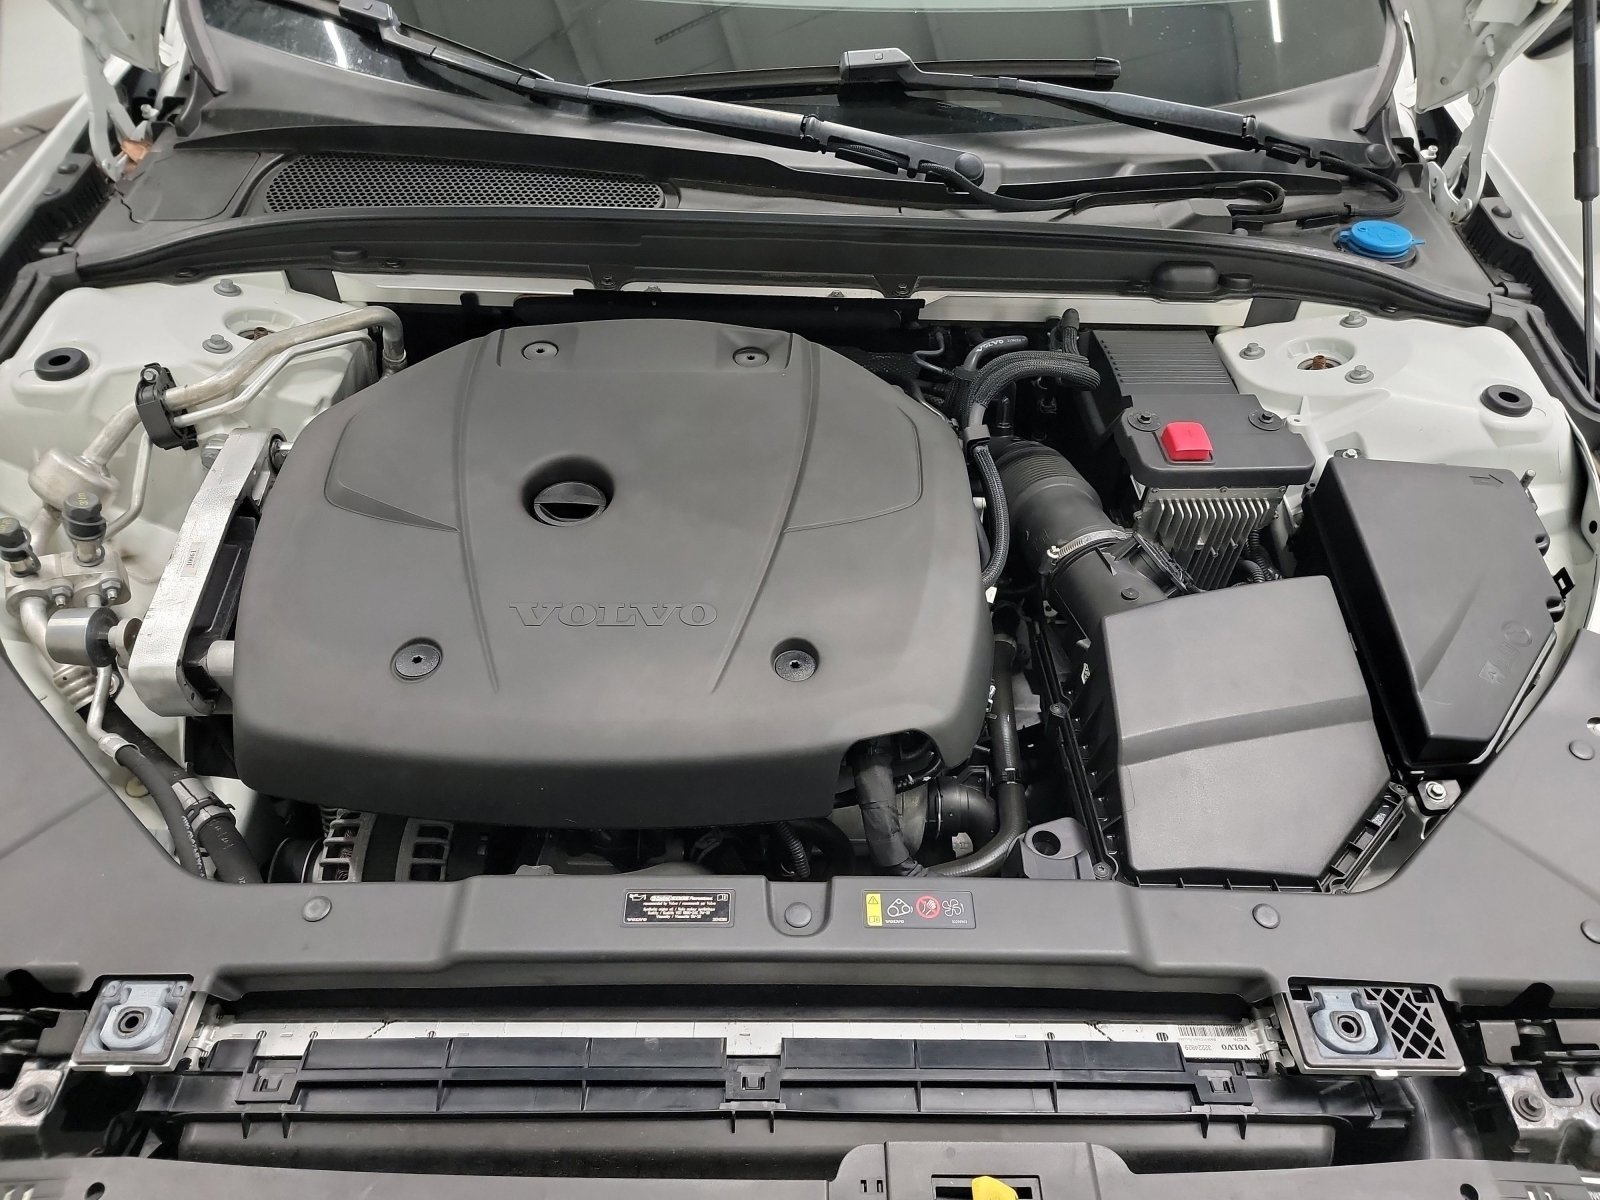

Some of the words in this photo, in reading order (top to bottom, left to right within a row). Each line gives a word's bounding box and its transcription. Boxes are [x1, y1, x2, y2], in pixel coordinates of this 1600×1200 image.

[975, 339, 1004, 352] VOLVO
[508, 602, 718, 627] VOLVO
[1221, 1043, 1251, 1051] VOLVO
